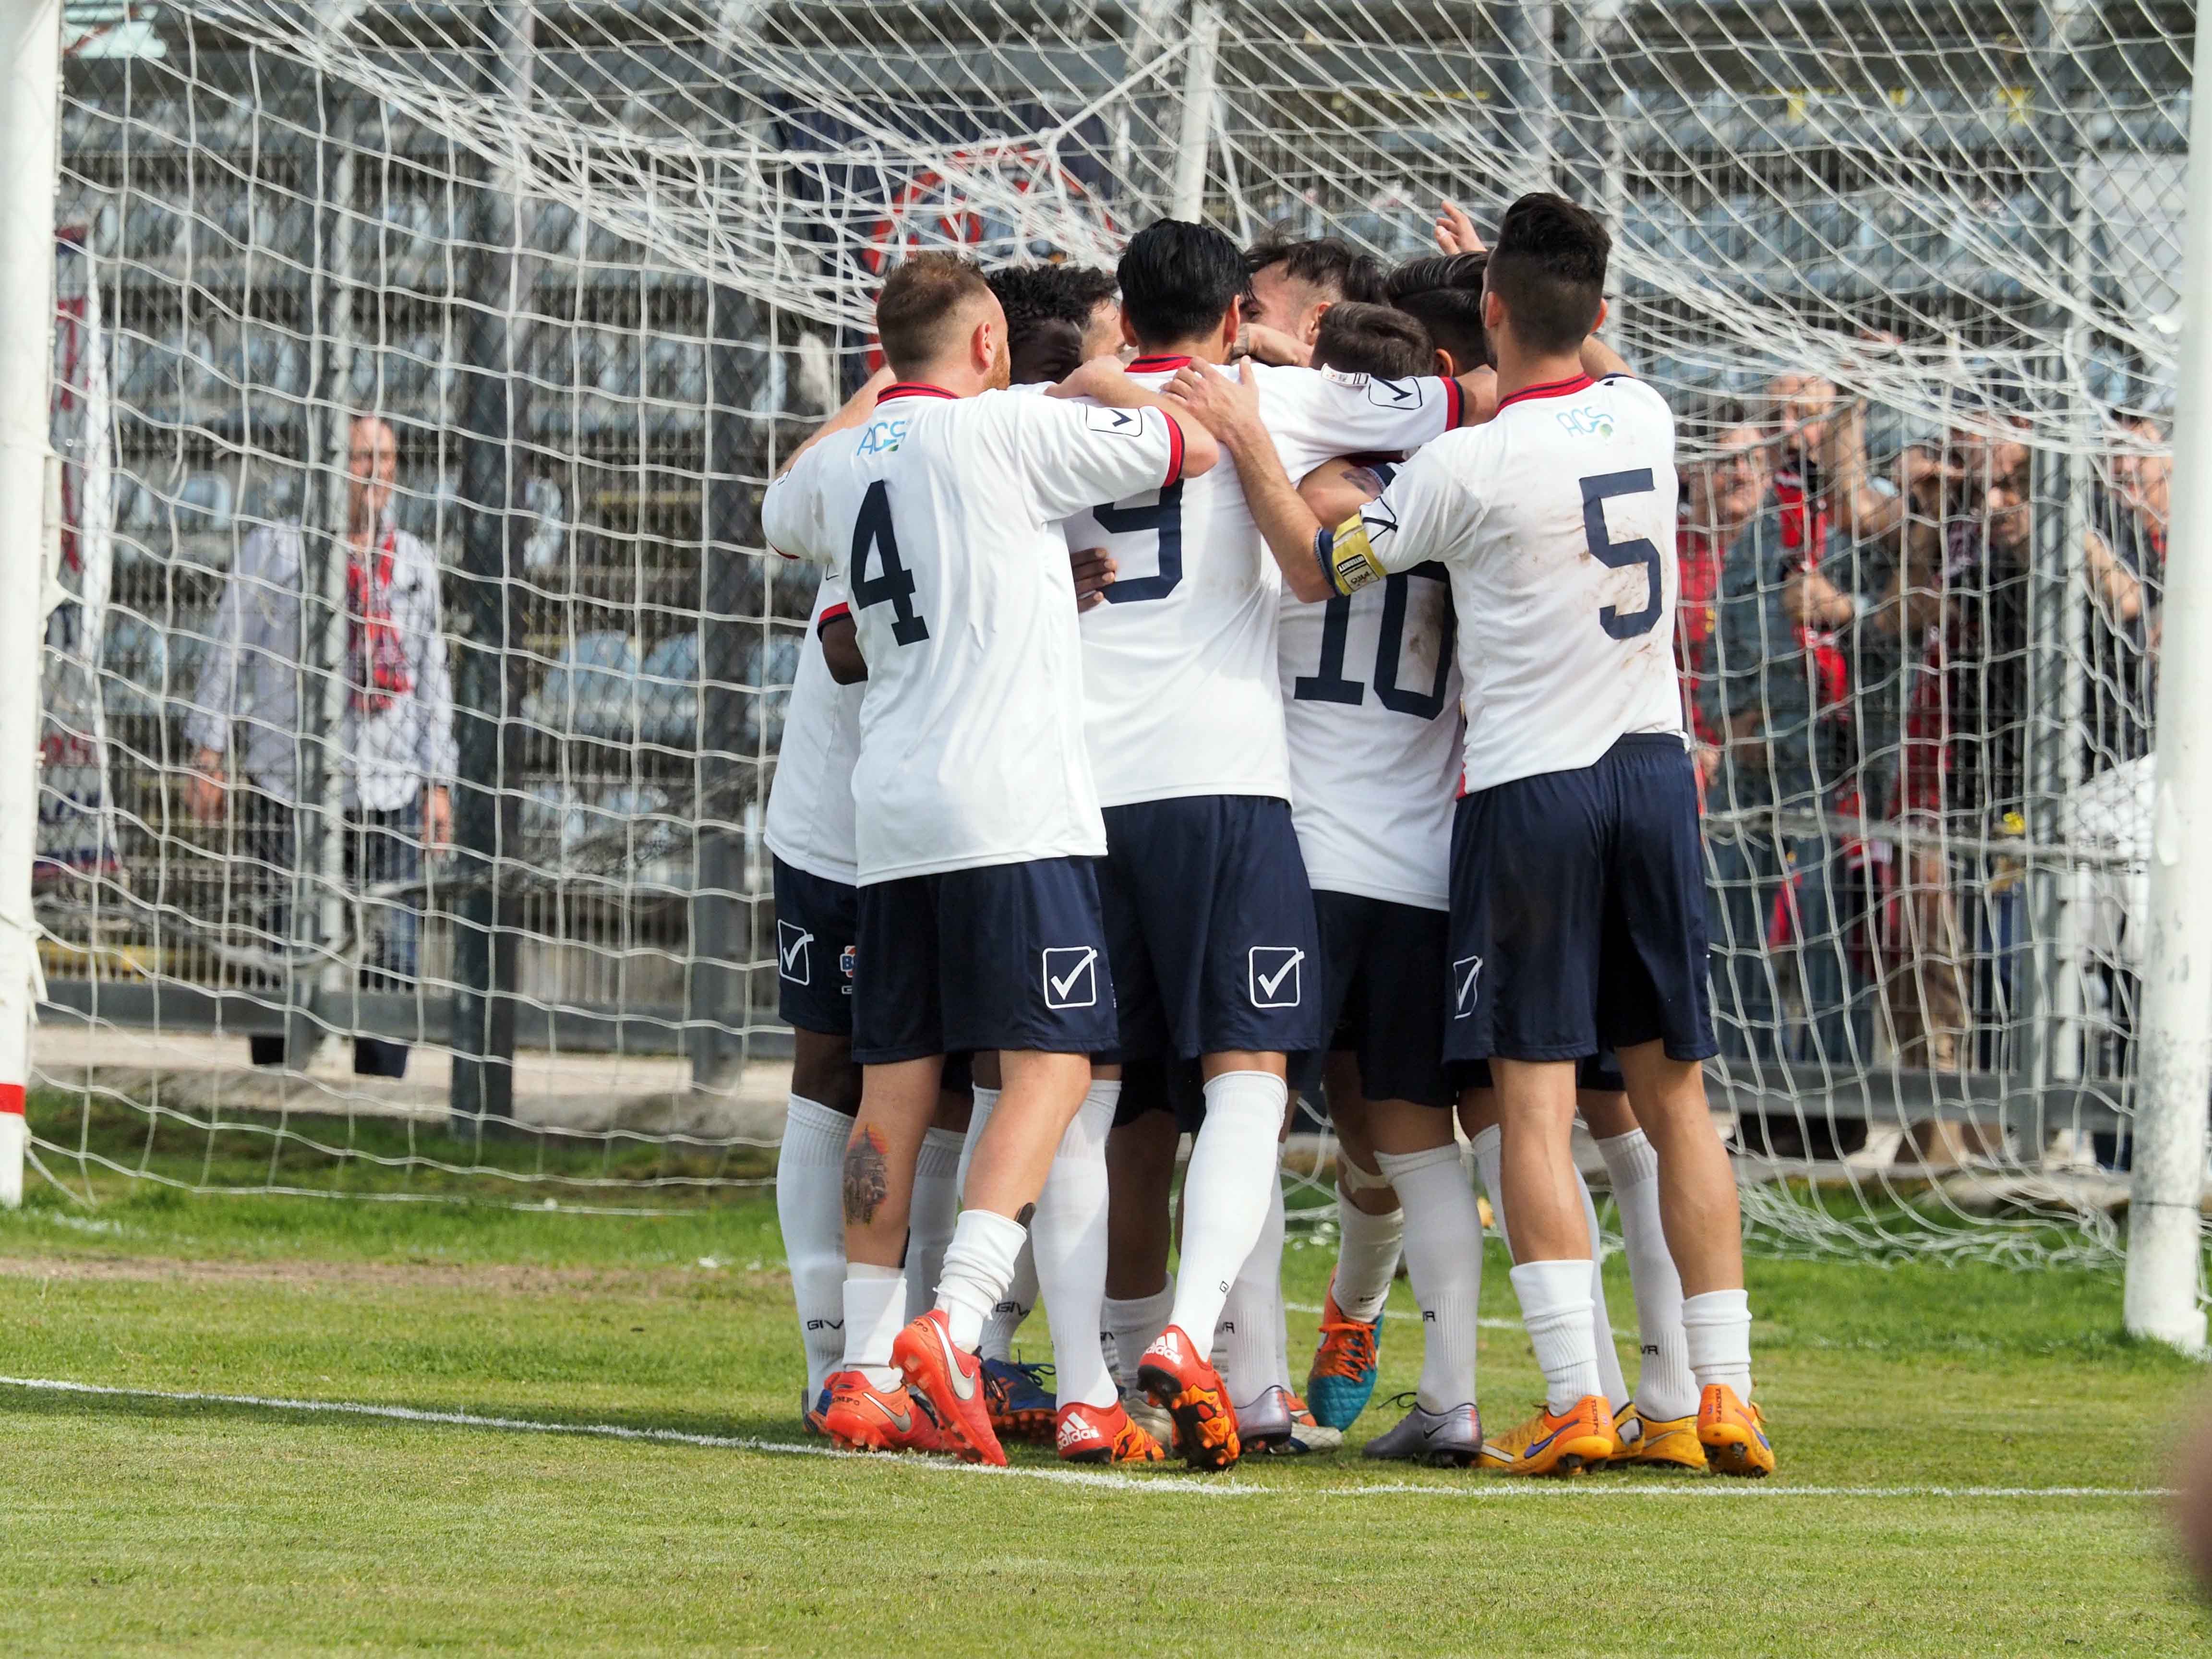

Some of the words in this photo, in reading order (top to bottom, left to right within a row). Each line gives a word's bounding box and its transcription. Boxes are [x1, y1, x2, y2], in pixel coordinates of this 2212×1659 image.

[856, 421, 906, 456] ACS
[1556, 406, 1614, 437] ACS
[851, 480, 929, 646] 4
[1093, 478, 1185, 604] 9
[1579, 468, 1662, 639] 5
[1294, 560, 1459, 721] 10
[807, 1319, 844, 1331] GIV
[1058, 1426, 1100, 1450] adidas
